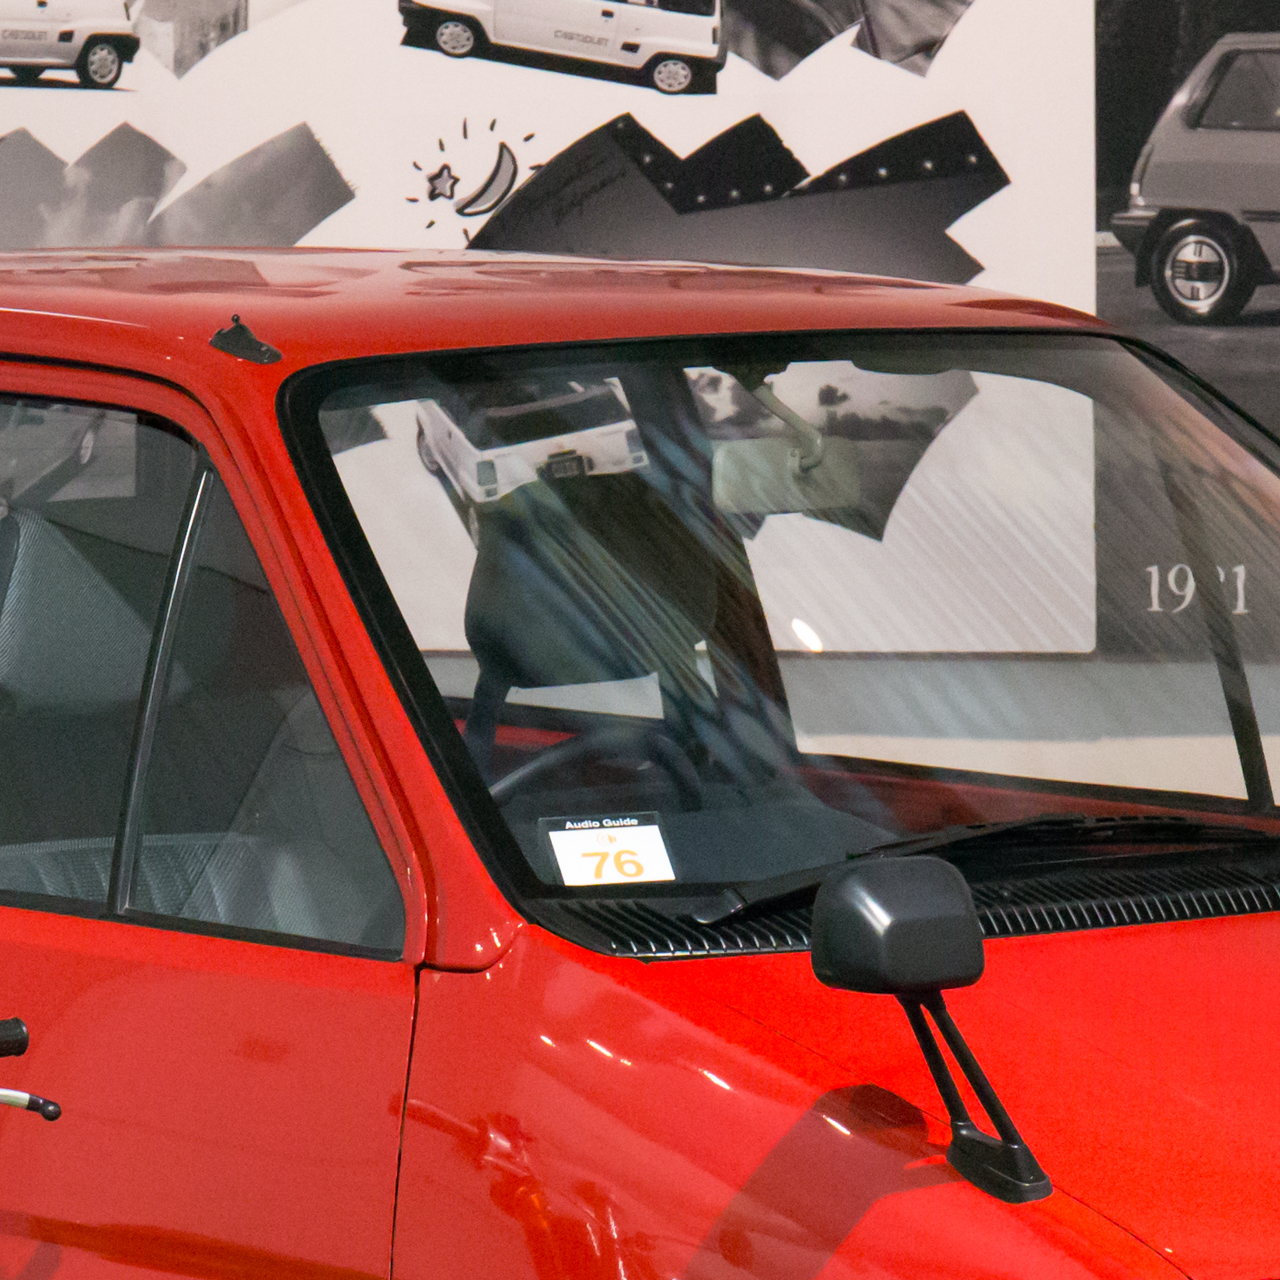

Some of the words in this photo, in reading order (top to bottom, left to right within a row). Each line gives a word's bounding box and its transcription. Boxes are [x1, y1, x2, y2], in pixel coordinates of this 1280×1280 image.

[1146, 564, 1249, 615] 191
[565, 820, 600, 830] Audio
[603, 817, 638, 828] Guide
[581, 850, 644, 879] 76
